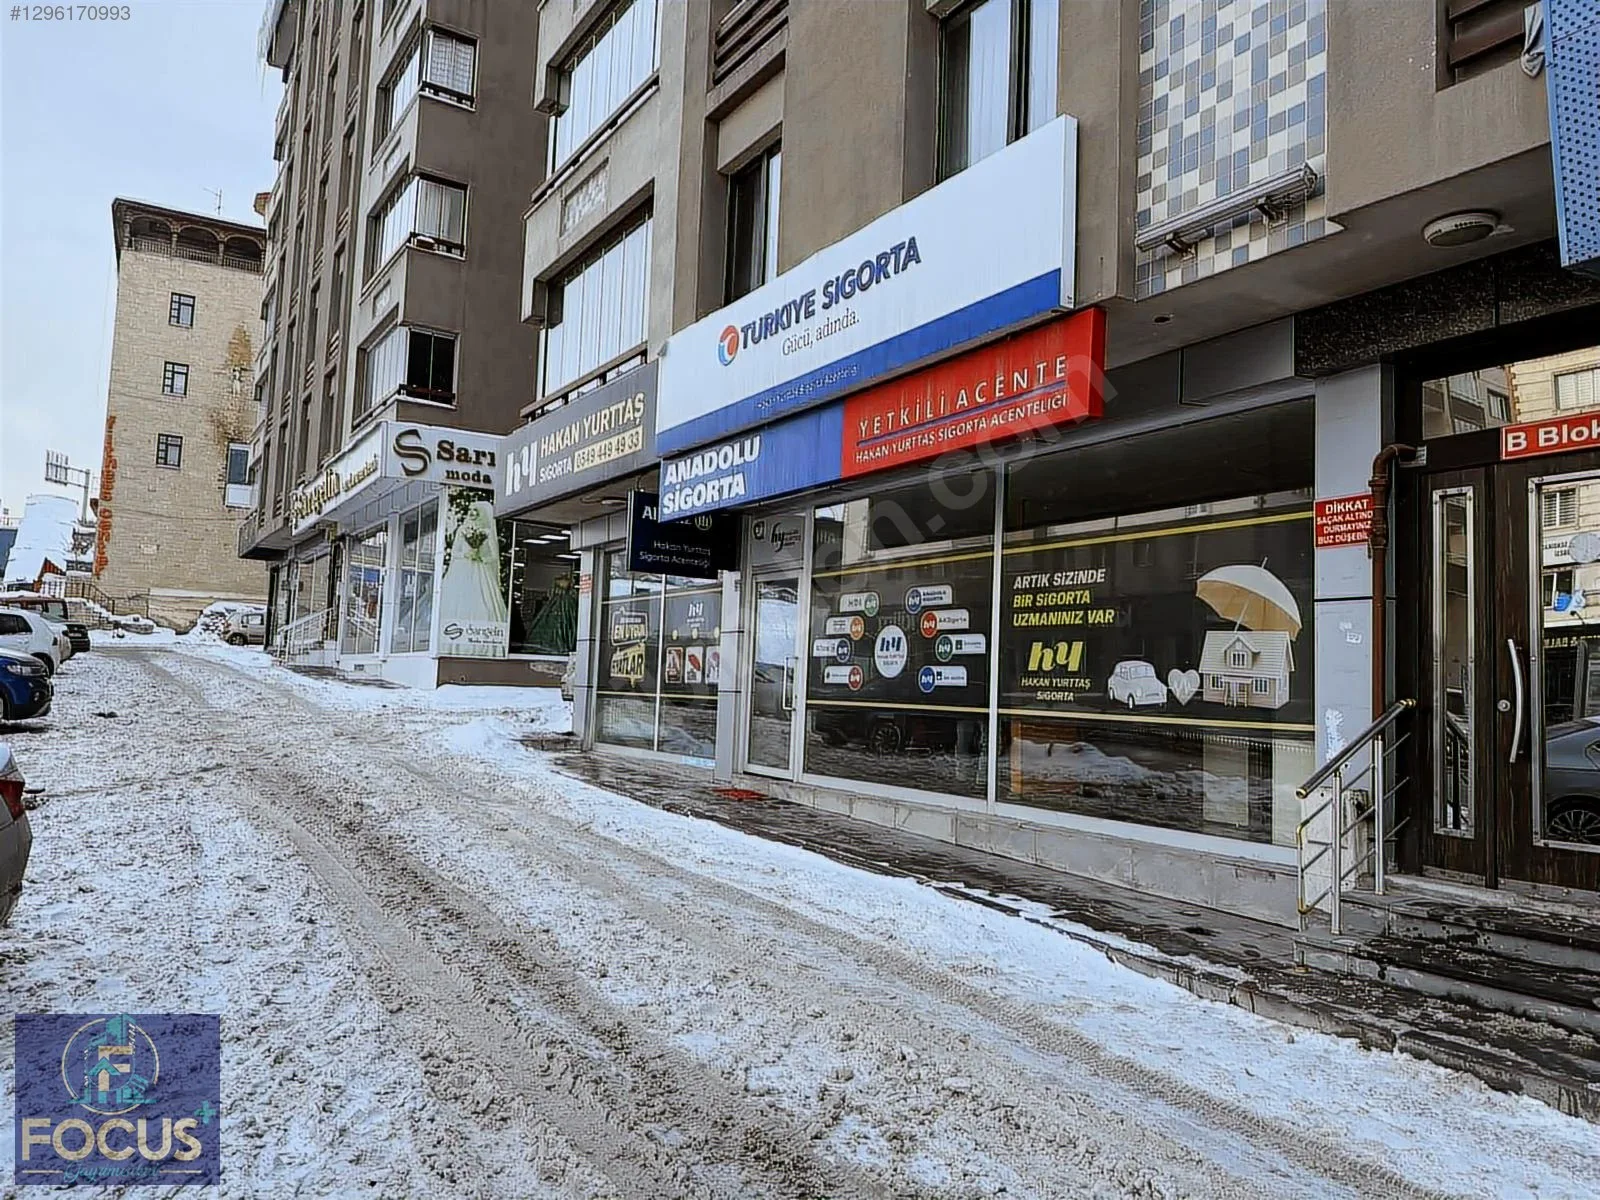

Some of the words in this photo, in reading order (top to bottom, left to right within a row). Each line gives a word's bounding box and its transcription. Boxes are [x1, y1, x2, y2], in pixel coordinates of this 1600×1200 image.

[782, 327, 813, 356] Gücü,
[816, 306, 860, 341] adında.
[860, 391, 945, 438] YETKİLİ
[956, 356, 1067, 410] ACENTE
[540, 422, 579, 458] HAKAN
[583, 393, 645, 439] YURTTAŞ
[597, 441, 613, 461] 449
[615, 435, 626, 454] 49
[628, 431, 640, 449] 33
[1507, 431, 1527, 452] B
[664, 436, 761, 486] ANADOLU
[856, 445, 889, 464] HAKAN
[445, 469, 492, 484] moda
[662, 472, 746, 515] SİGORTA
[1325, 499, 1369, 514] DİKKAT
[1317, 514, 1344, 525] SAÇAK
[1318, 535, 1334, 545] BUZ
[1013, 573, 1051, 589] ARTIK
[1053, 568, 1106, 586] SİZİNDE
[1013, 594, 1033, 608] BİR
[1036, 590, 1091, 606] SİGORTA
[1013, 610, 1084, 626] UZMANINIZ
[1087, 609, 1115, 624] VAR
[1028, 641, 1083, 671] hy
[1021, 677, 1051, 687] HAKAN
[1052, 678, 1092, 691] YURTTAŞ
